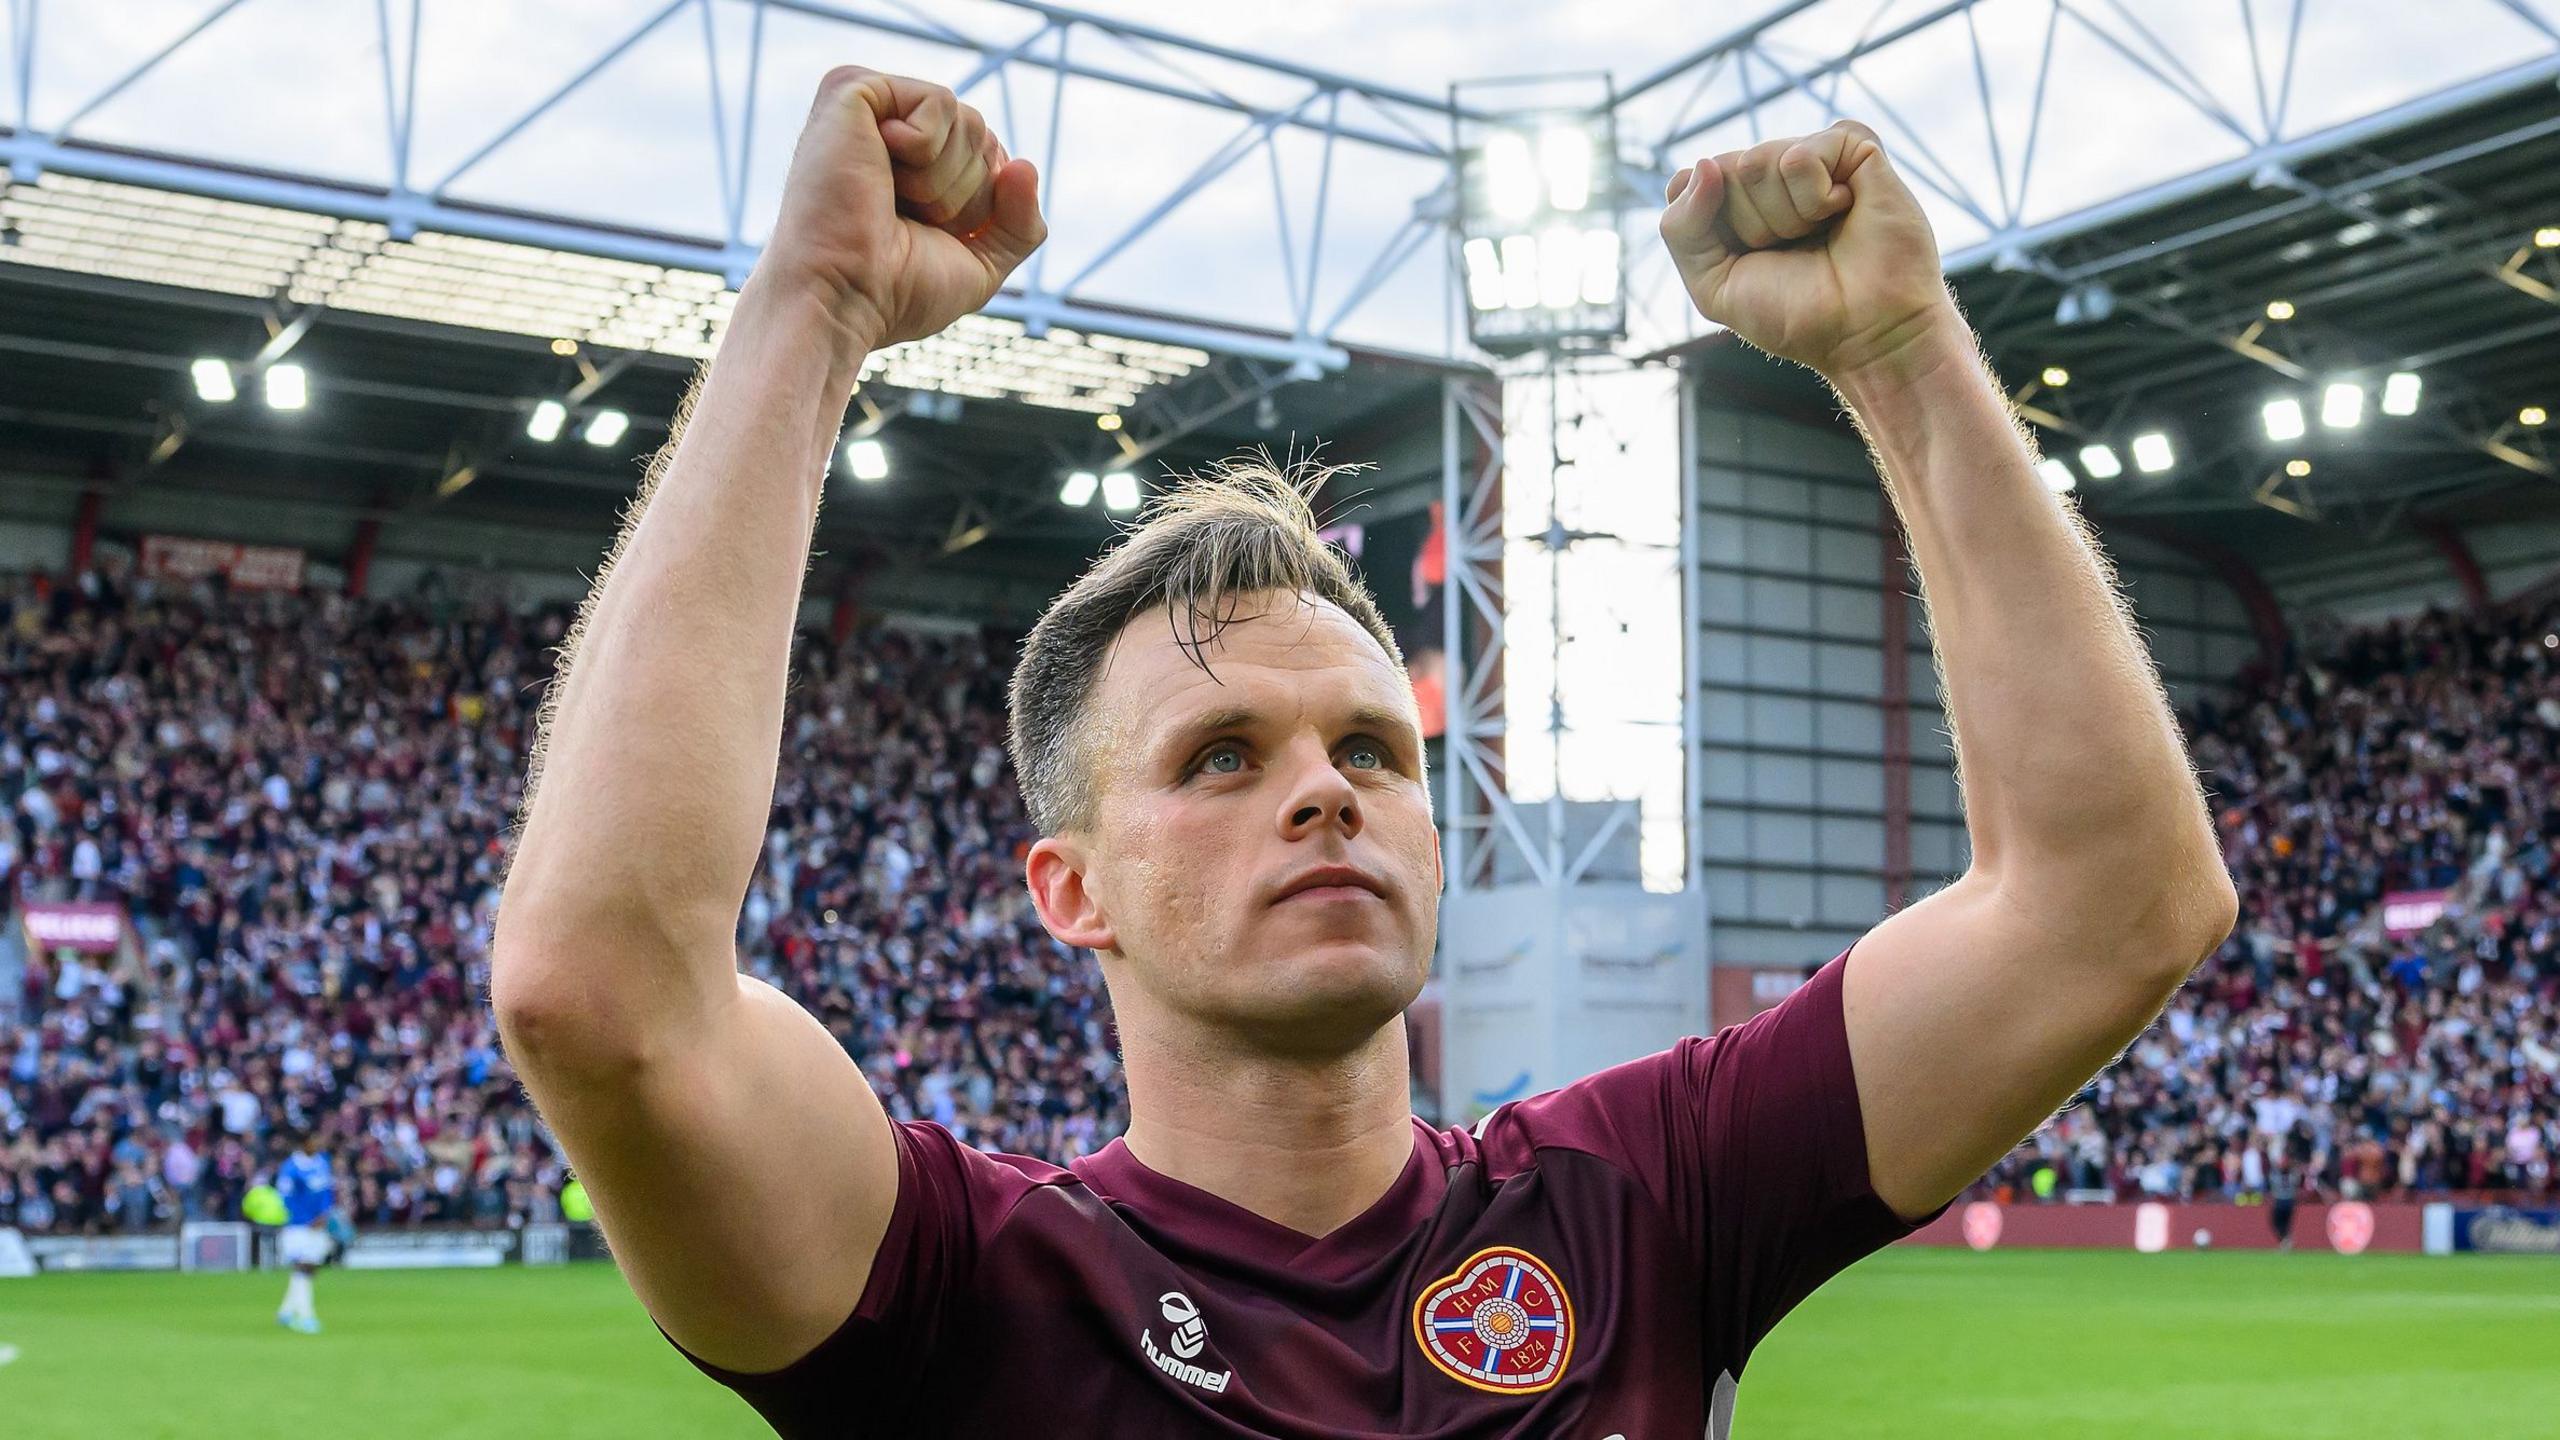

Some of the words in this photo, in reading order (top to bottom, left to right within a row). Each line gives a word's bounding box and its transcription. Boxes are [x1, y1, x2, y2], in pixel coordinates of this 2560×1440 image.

[1523, 1290, 1543, 1307] C
[1456, 1335, 1474, 1355] F
[1510, 1339, 1546, 1370] 1874
[1140, 1328, 1232, 1393] hummel
